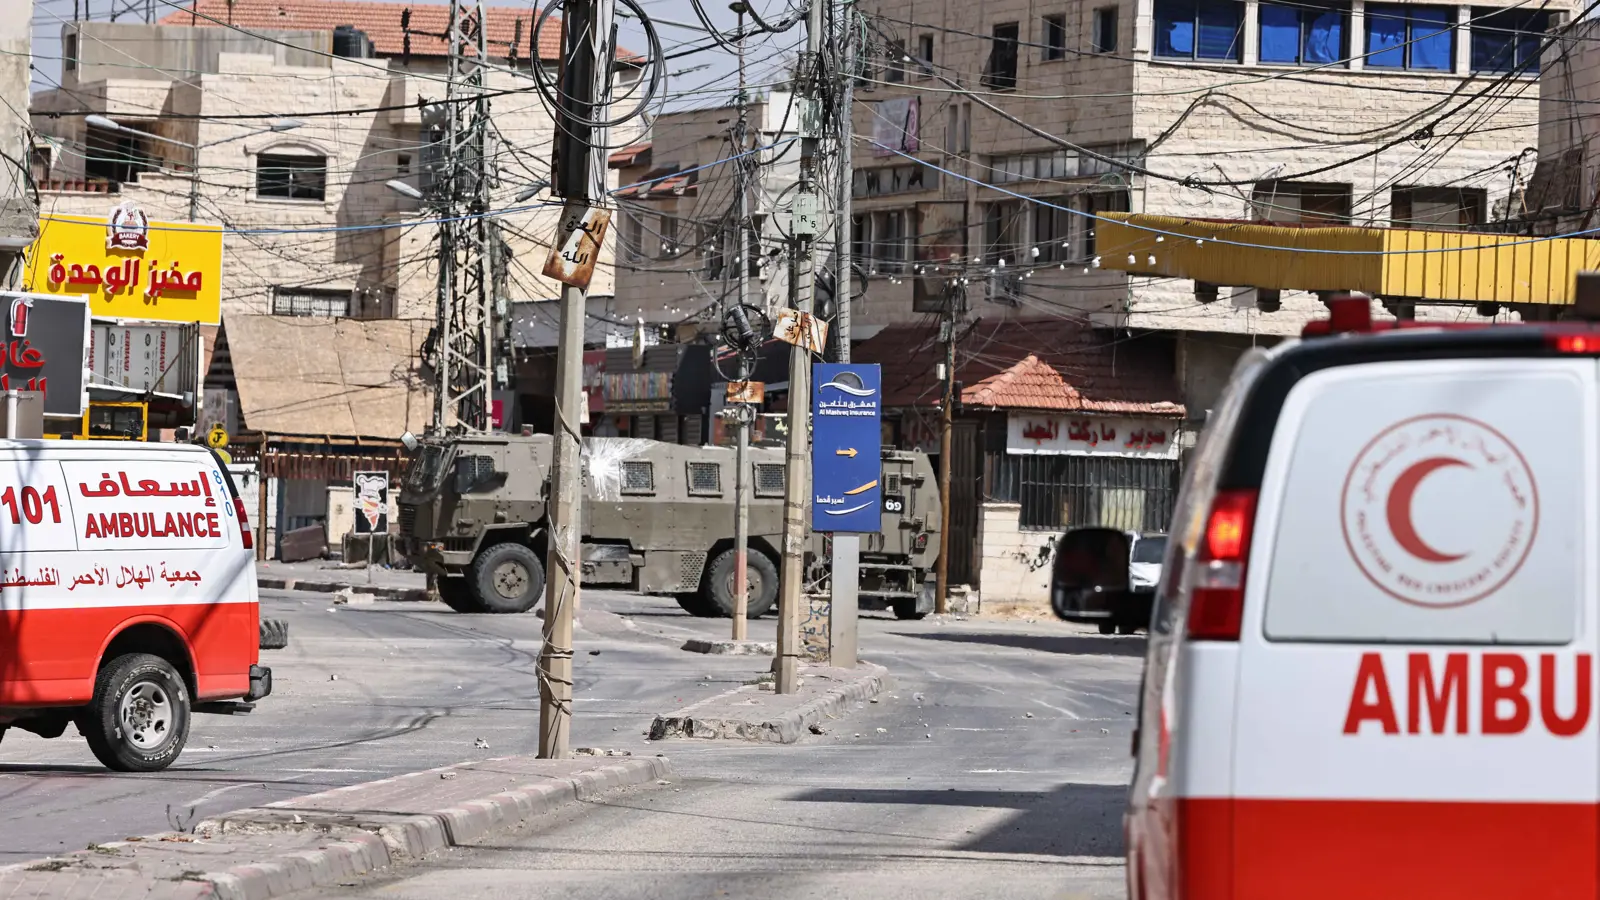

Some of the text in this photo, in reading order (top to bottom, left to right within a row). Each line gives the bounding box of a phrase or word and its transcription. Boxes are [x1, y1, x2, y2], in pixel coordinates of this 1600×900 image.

[801, 215, 807, 223] R
[118, 232, 140, 240] BAKERY
[50, 254, 202, 297] مخبز الوحدة
[79, 471, 216, 507] إسعاف
[212, 469, 233, 517] 810
[1, 485, 62, 525] 101
[85, 511, 222, 539] AMBULANCE
[67, 562, 110, 591] الأحمر
[116, 564, 155, 590] الهلال
[160, 561, 202, 588] جمعية
[1341, 652, 1593, 740] AMBU
